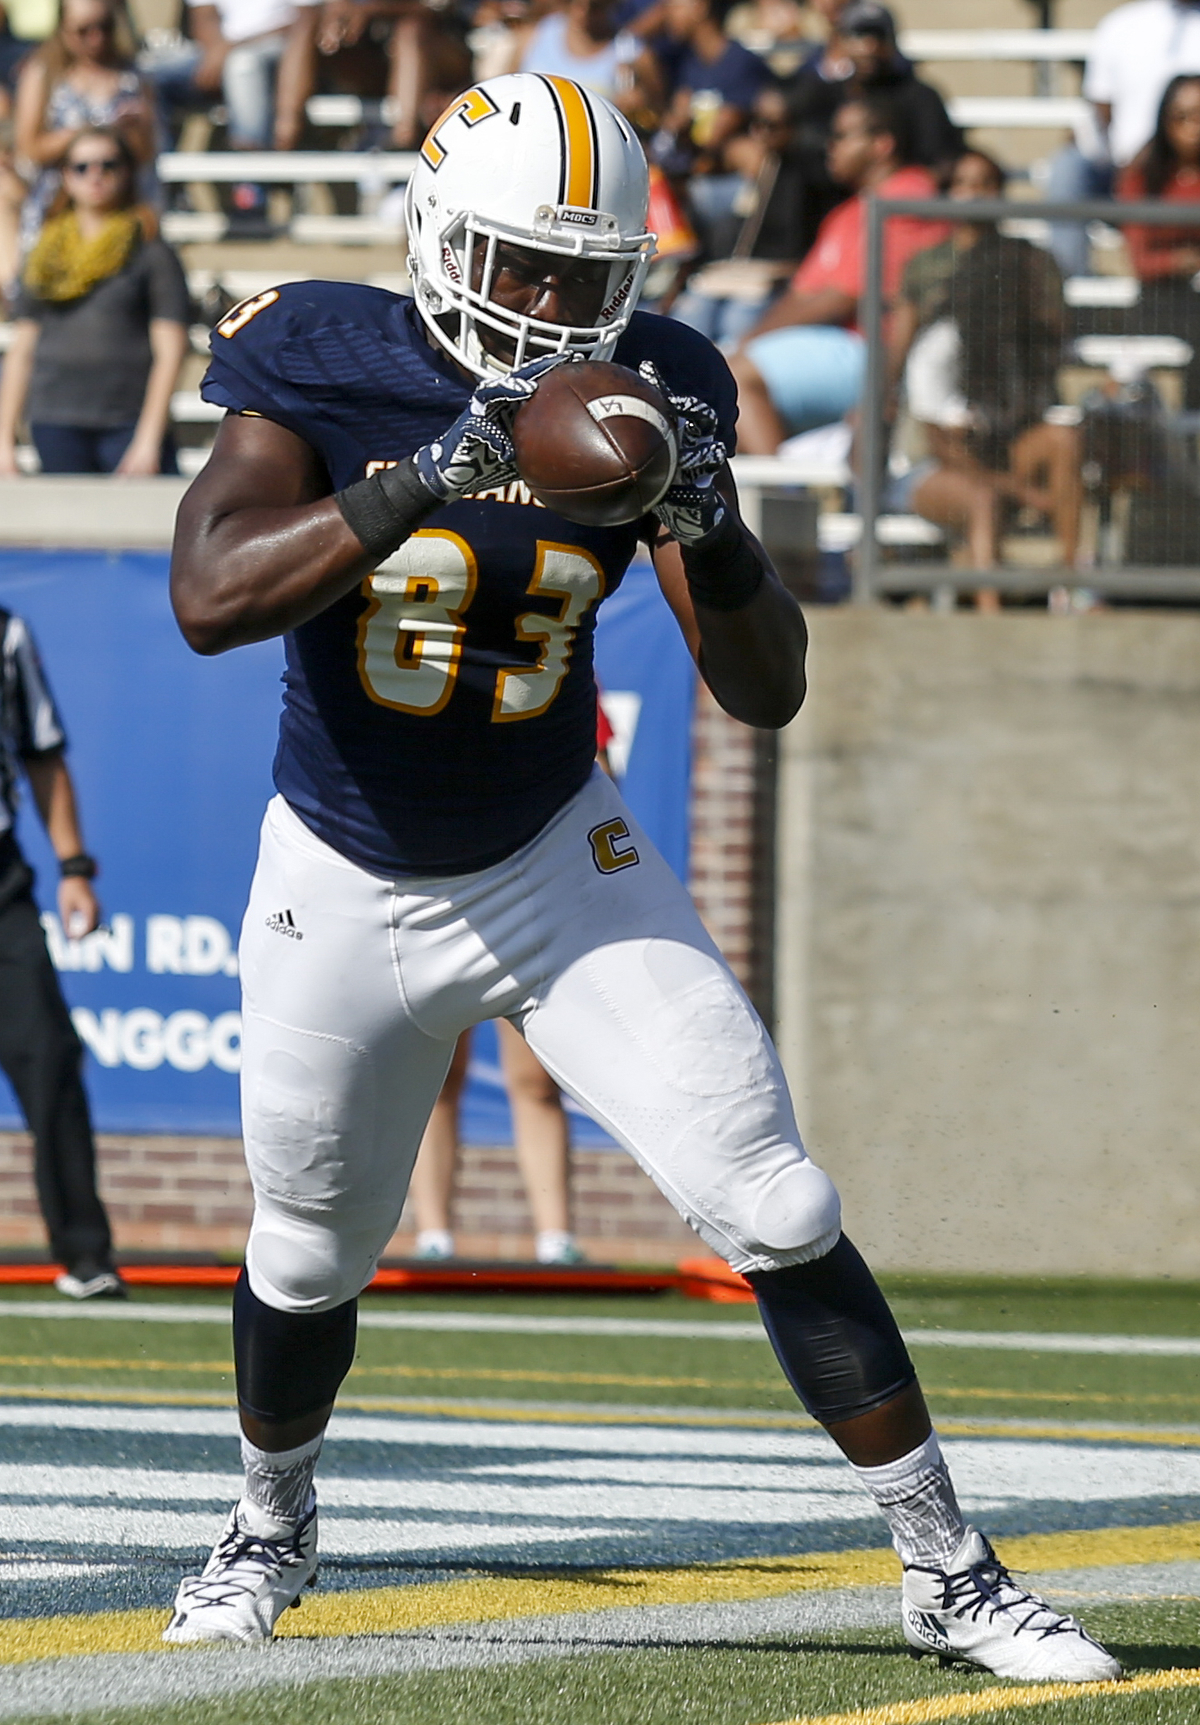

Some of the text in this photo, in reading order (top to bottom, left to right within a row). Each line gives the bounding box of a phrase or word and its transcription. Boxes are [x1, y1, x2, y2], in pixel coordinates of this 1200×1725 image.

[562, 211, 598, 225] MOCS
[356, 527, 606, 723] 83
[587, 816, 640, 875] C
[146, 915, 238, 977] RD.
[265, 917, 303, 941] adidas
